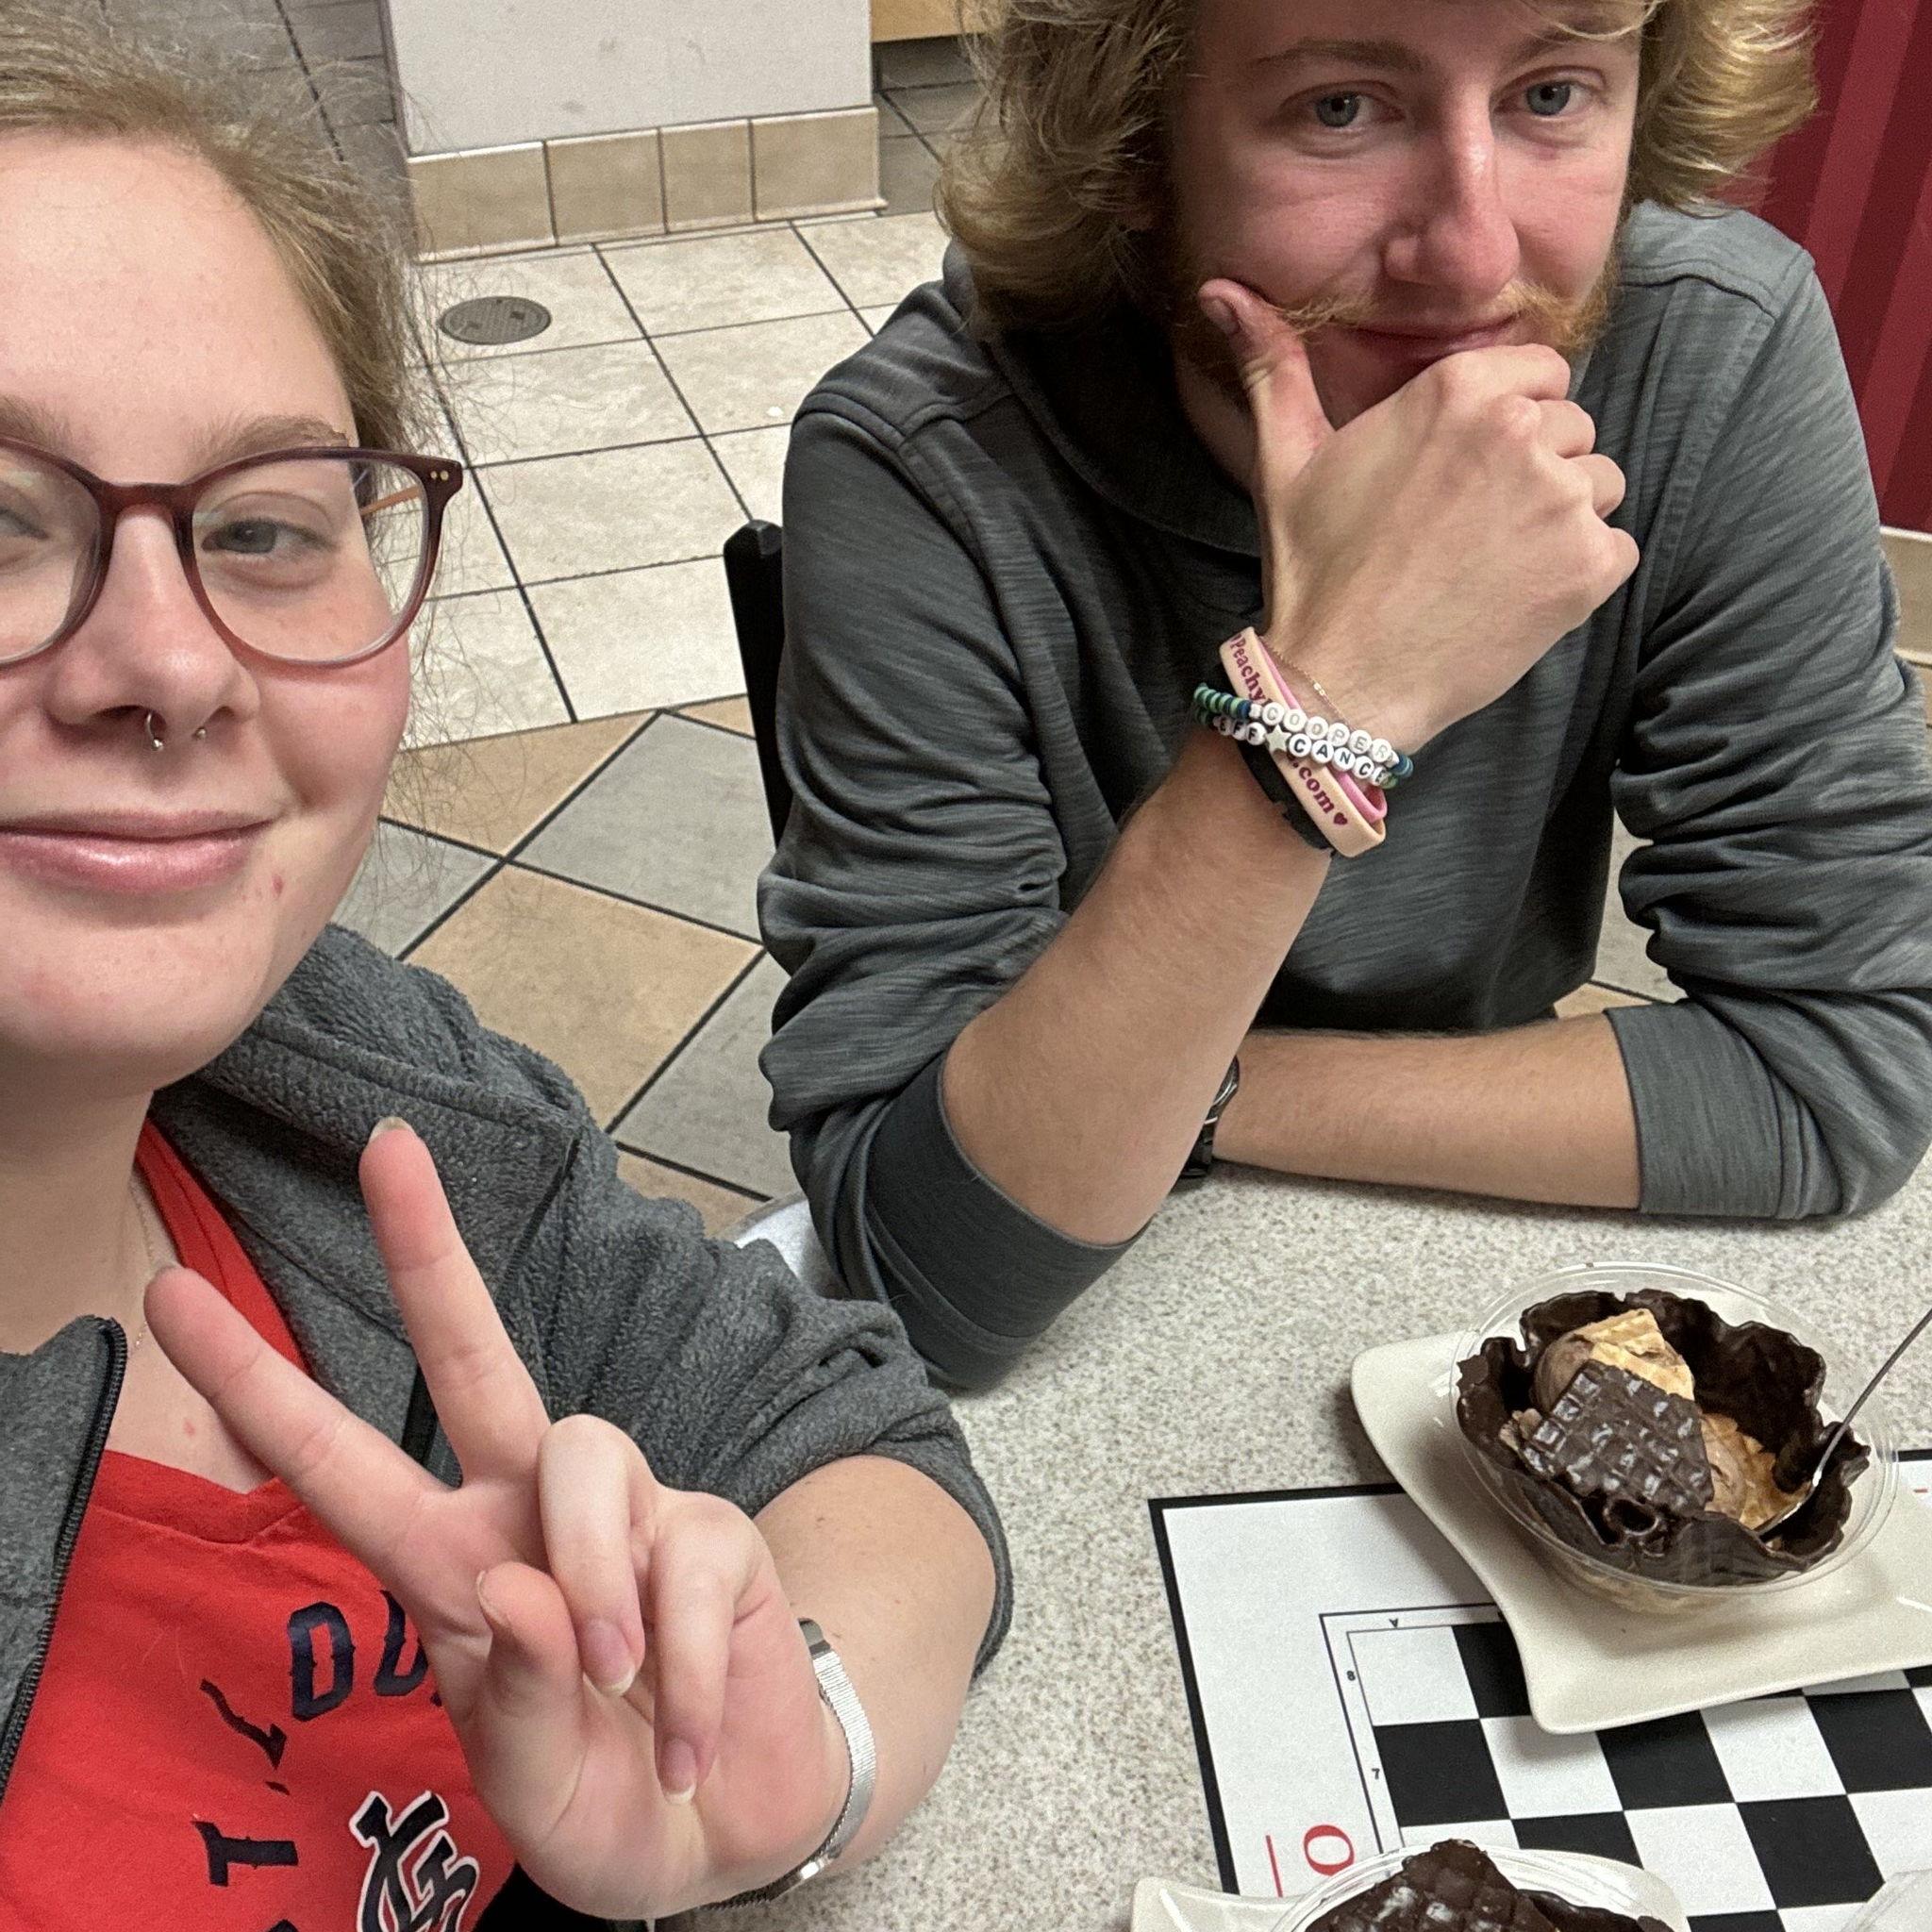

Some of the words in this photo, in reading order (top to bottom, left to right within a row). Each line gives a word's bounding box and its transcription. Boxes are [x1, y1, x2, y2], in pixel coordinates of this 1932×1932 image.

[1266, 706, 1391, 760] COOPER
[1346, 1670, 1357, 1682] 8
[1371, 1768, 1381, 1780] 7
